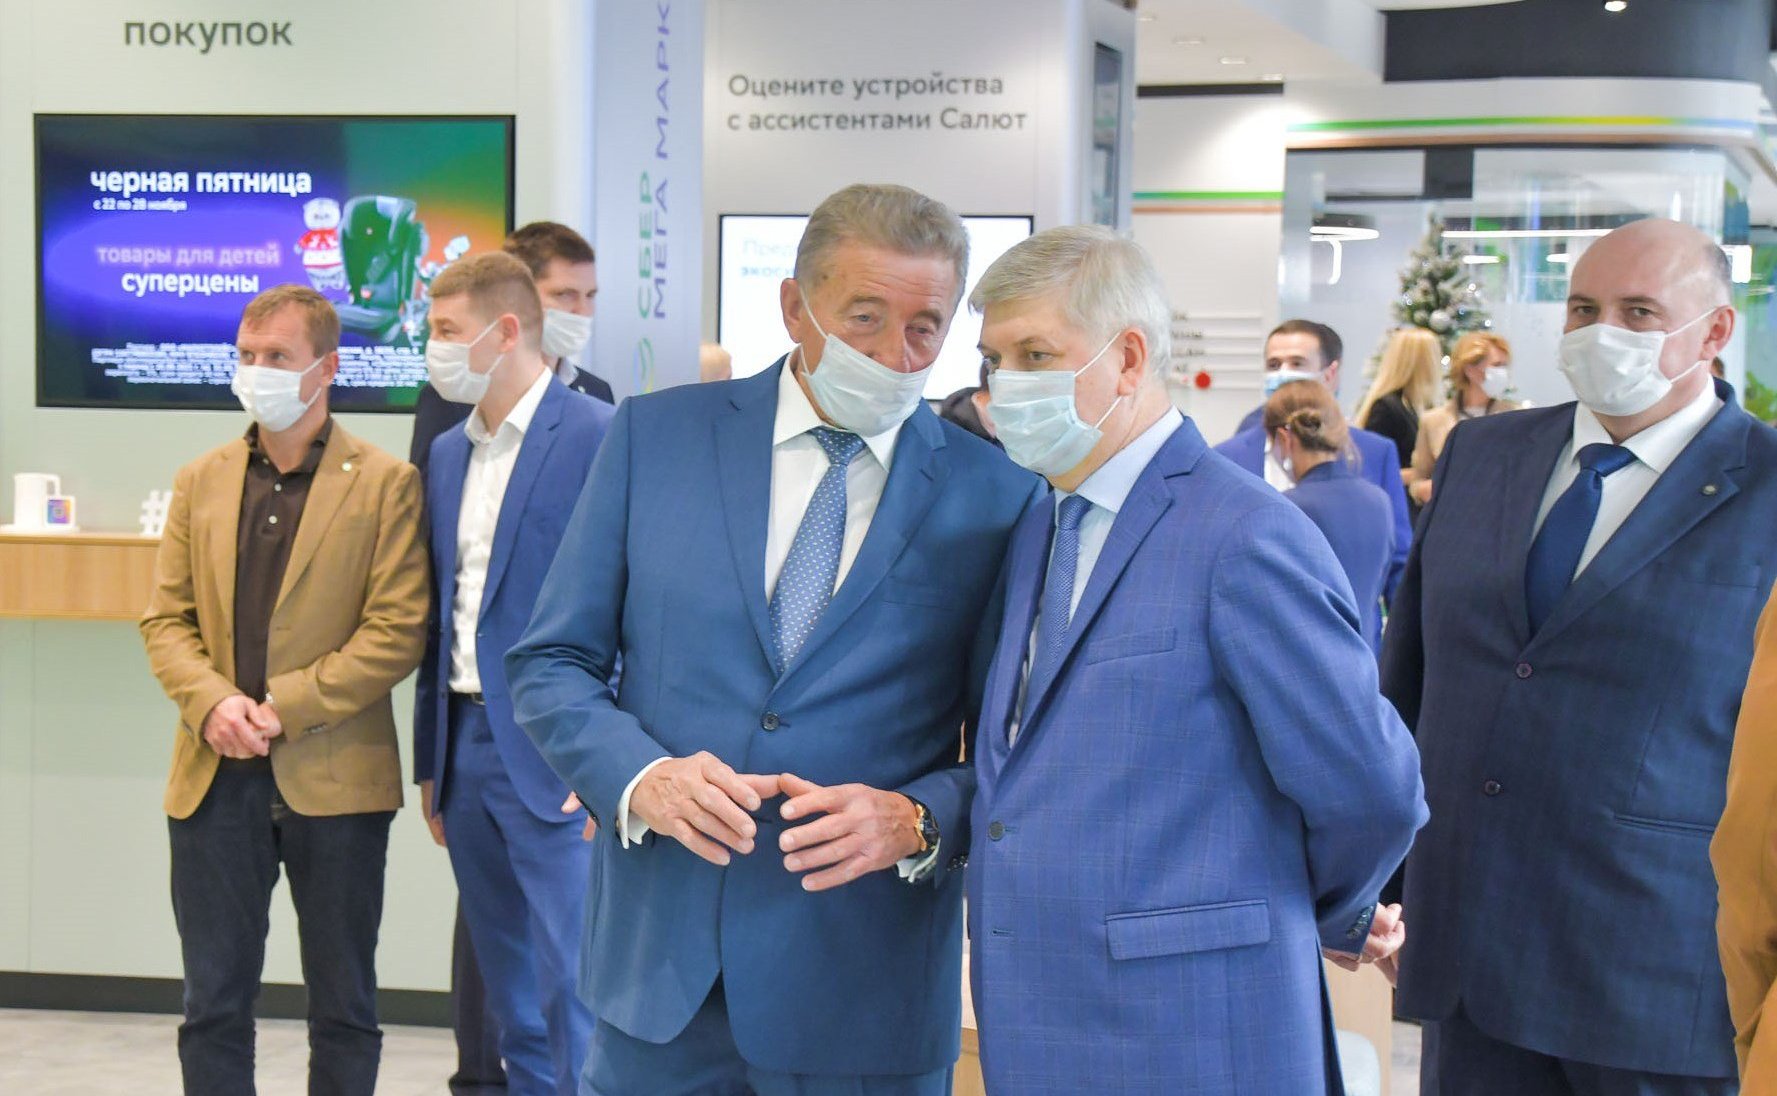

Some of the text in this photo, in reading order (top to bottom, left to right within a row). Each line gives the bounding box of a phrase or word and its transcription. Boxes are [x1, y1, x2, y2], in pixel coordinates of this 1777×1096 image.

[124, 22, 293, 55] покупок
[728, 71, 1004, 101] Оцените устройства
[727, 107, 1027, 132] с ассистентами Салют
[90, 171, 312, 198] черная пятница
[98, 242, 280, 267] товары для детей
[638, 171, 653, 319] СБЕР
[653, 178, 668, 319] МЕГА
[121, 272, 259, 297] суперцены
